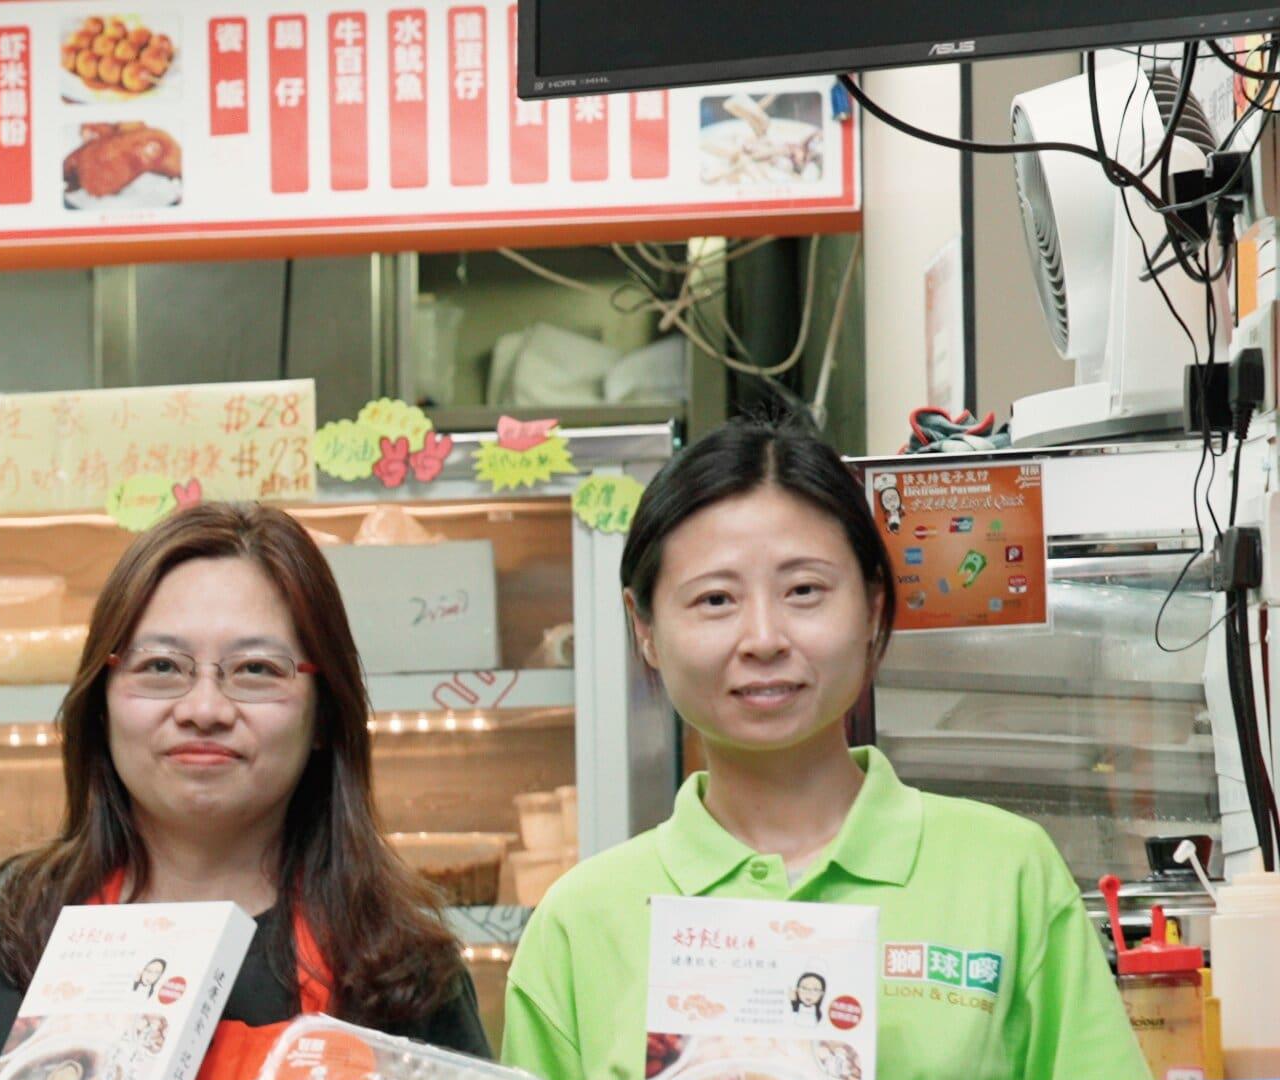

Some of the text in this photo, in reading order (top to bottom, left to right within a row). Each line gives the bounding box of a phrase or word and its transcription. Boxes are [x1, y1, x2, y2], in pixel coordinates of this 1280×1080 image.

[928, 40, 976, 56] ASUS
[885, 946, 1001, 988] 獅球嘜
[883, 984, 924, 998] LION
